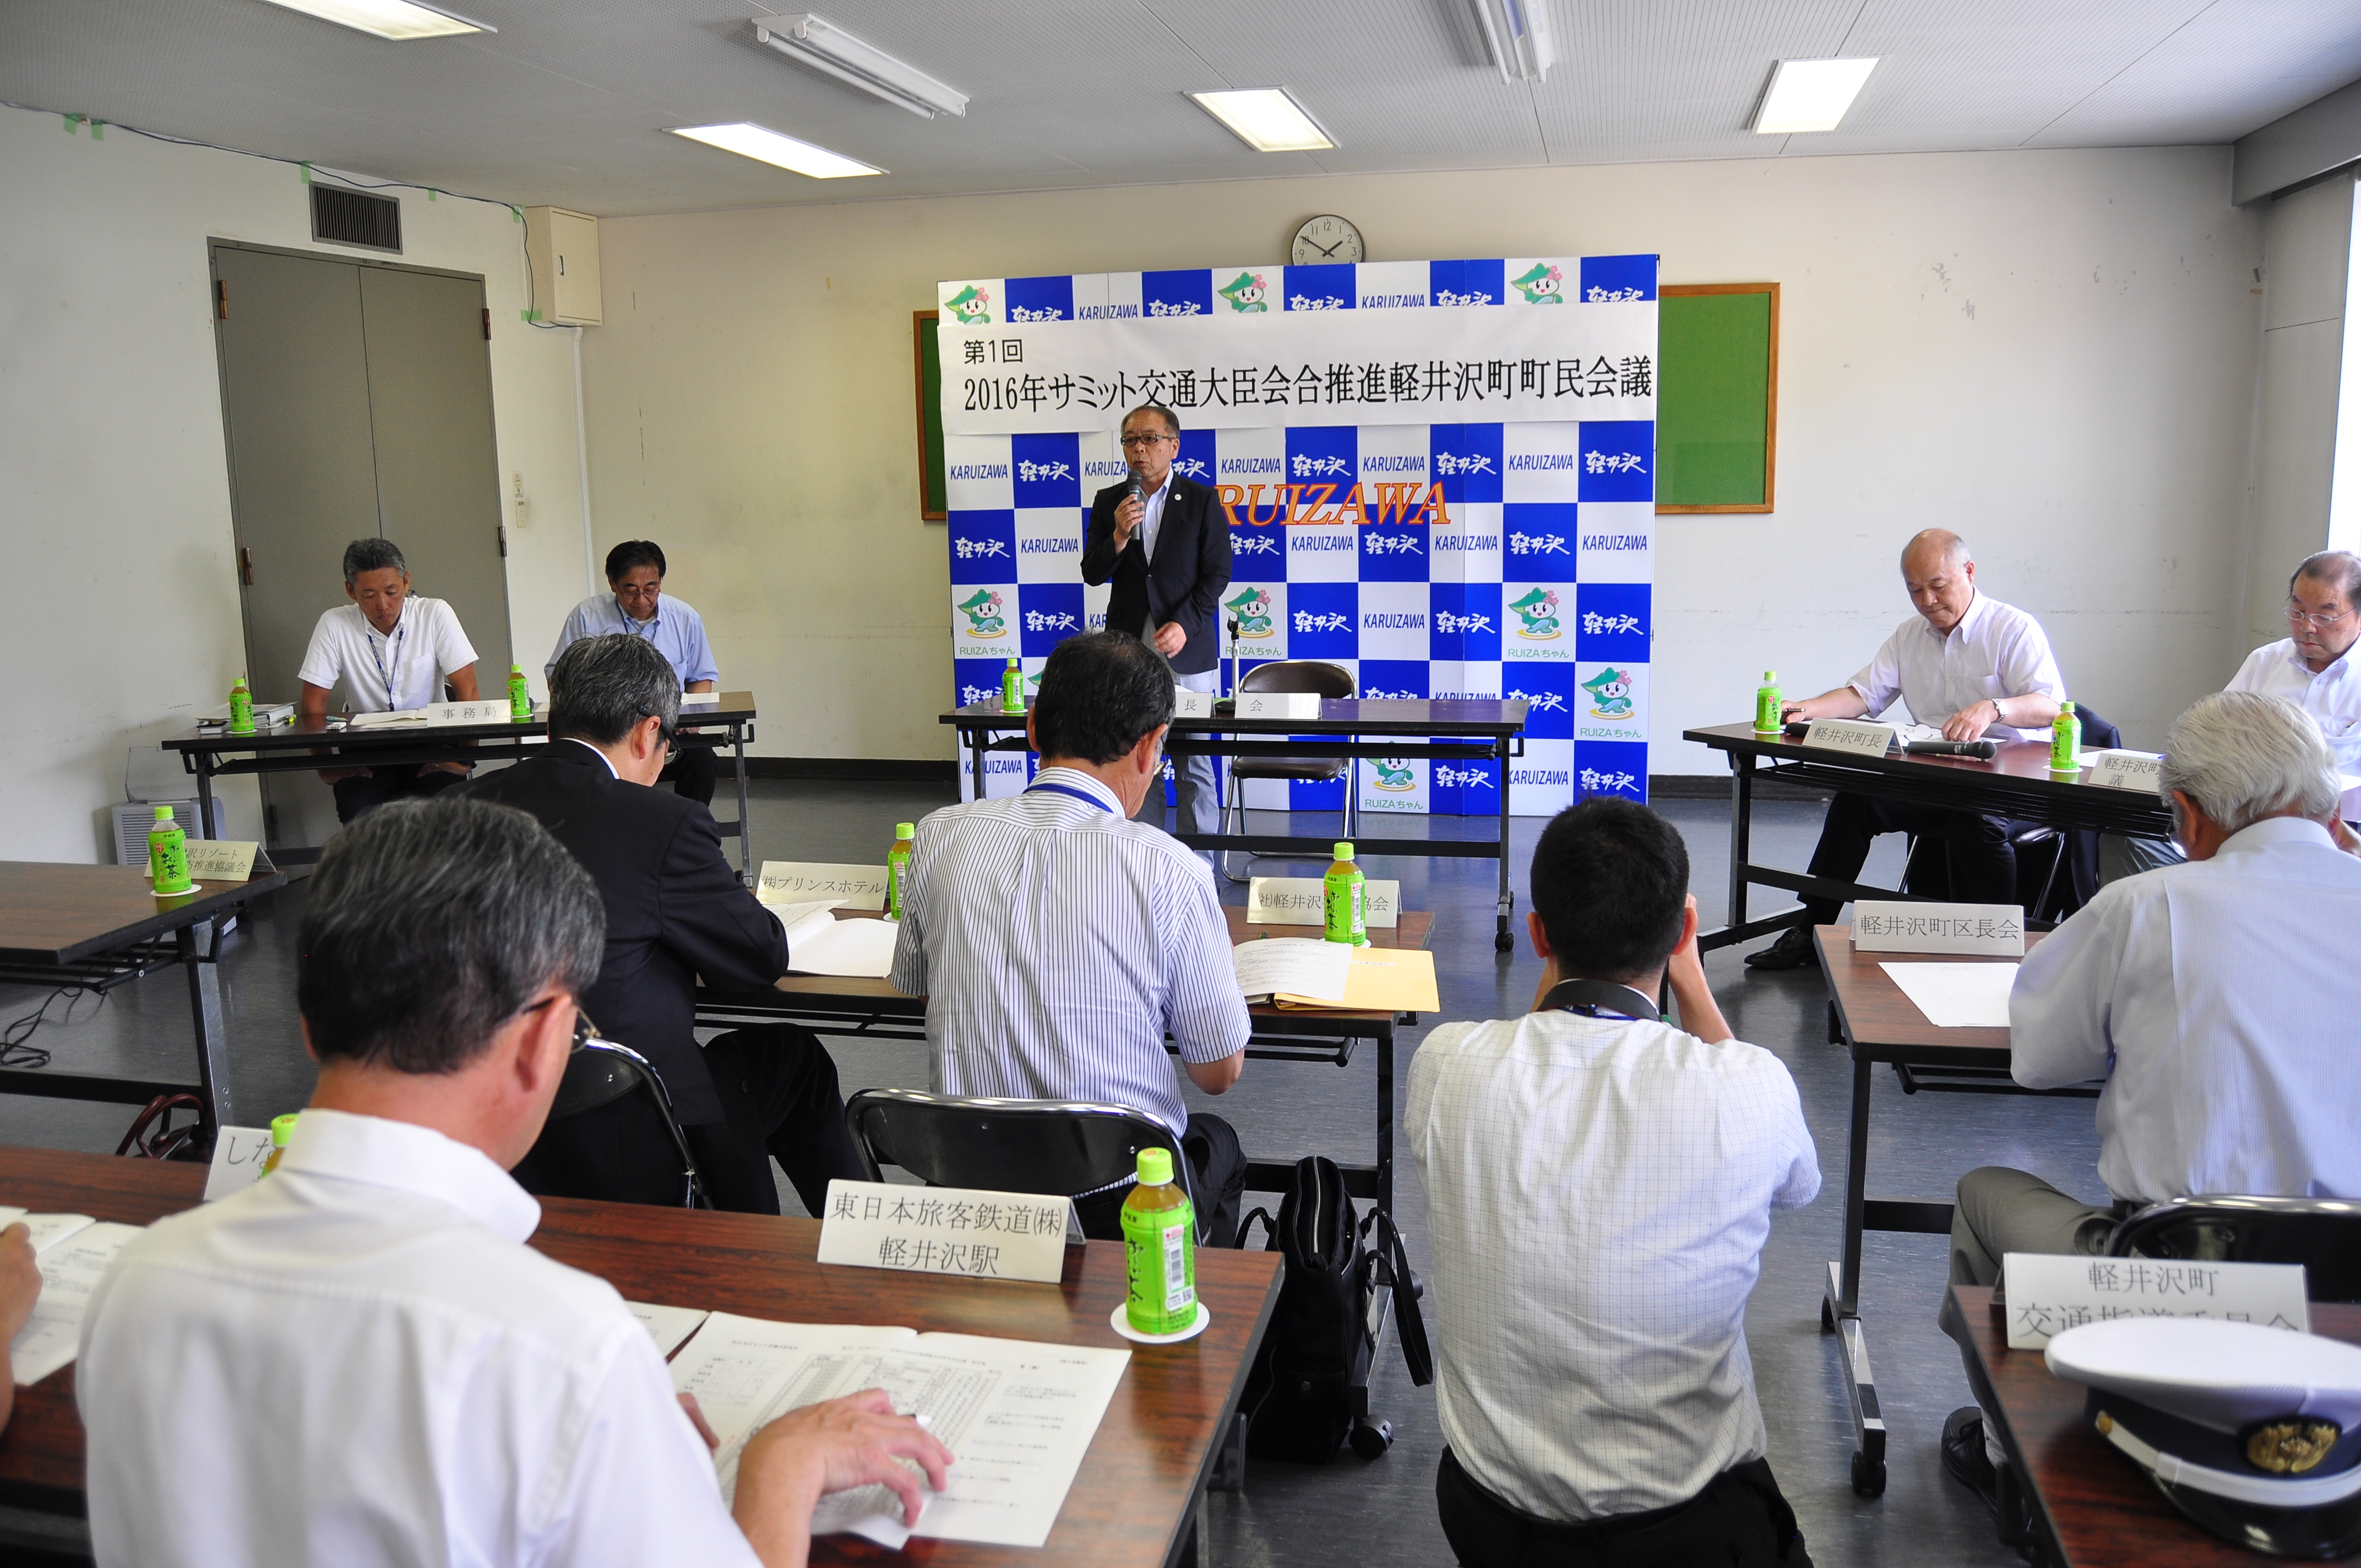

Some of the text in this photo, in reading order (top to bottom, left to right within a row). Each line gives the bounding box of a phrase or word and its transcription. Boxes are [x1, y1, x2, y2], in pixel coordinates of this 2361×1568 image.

[1312, 225, 1318, 235] 11
[1324, 221, 1331, 231] 12
[1339, 225, 1342, 234] 1
[1302, 235, 1309, 244] 10
[1348, 233, 1352, 243] 2
[1299, 249, 1305, 258] 9
[1351, 247, 1357, 256] 3
[1362, 294, 1425, 309] KARUIZAWA
[1079, 304, 1138, 320] KARUIZAWA
[964, 338, 1023, 365] 第1回
[964, 354, 1652, 413] 2016年サミット交通大臣会合推進軽井沢町町民会議
[1018, 459, 1074, 482] 軽井沢
[1085, 461, 1129, 477] KARUIZA
[1172, 458, 1210, 478] 井沢
[1221, 458, 1281, 474] KARUIZAWA
[1292, 454, 1352, 477] 軽井沢
[1363, 456, 1425, 472] KARUIZAWA
[1436, 451, 1496, 476] 軽井沢
[1509, 454, 1574, 471] KARUIZAWA
[1585, 450, 1646, 476] 軽井沢
[950, 464, 1008, 480] KARUIZAWA
[1214, 481, 1451, 526] RUIZAWA
[955, 536, 1010, 559] 軽井沢
[1021, 537, 1079, 553] KARUIZAWA
[1292, 535, 1354, 552] KARUIZAWA
[1364, 531, 1424, 556] 軽井沢
[1435, 535, 1498, 551] KARUIZAWA
[1508, 531, 1570, 556] 軽井沢
[1582, 535, 1648, 552] KARUIZAWA
[1026, 610, 1080, 631] 軽井沢
[1293, 609, 1353, 634] 軽井沢
[1363, 613, 1425, 630] KARUIZAWA
[1436, 610, 1497, 634] 軽井沢
[1582, 610, 1645, 636] 軽井沢
[1226, 646, 1282, 656] RIZAちゃん
[442, 706, 496, 720] 事務局
[1184, 699, 1197, 711] 長
[1813, 726, 1883, 748] 軽井沢町長
[965, 760, 1022, 774] KUIZAWA
[1435, 764, 1495, 790] 軽井沢
[1509, 770, 1569, 785] KARUIZAWA
[2108, 774, 2124, 787] 議
[1860, 914, 2019, 940] 軽井沢町区長会
[878, 1235, 1000, 1276] 軽井沢駅
[2087, 1260, 2219, 1296] 軽井沢町
